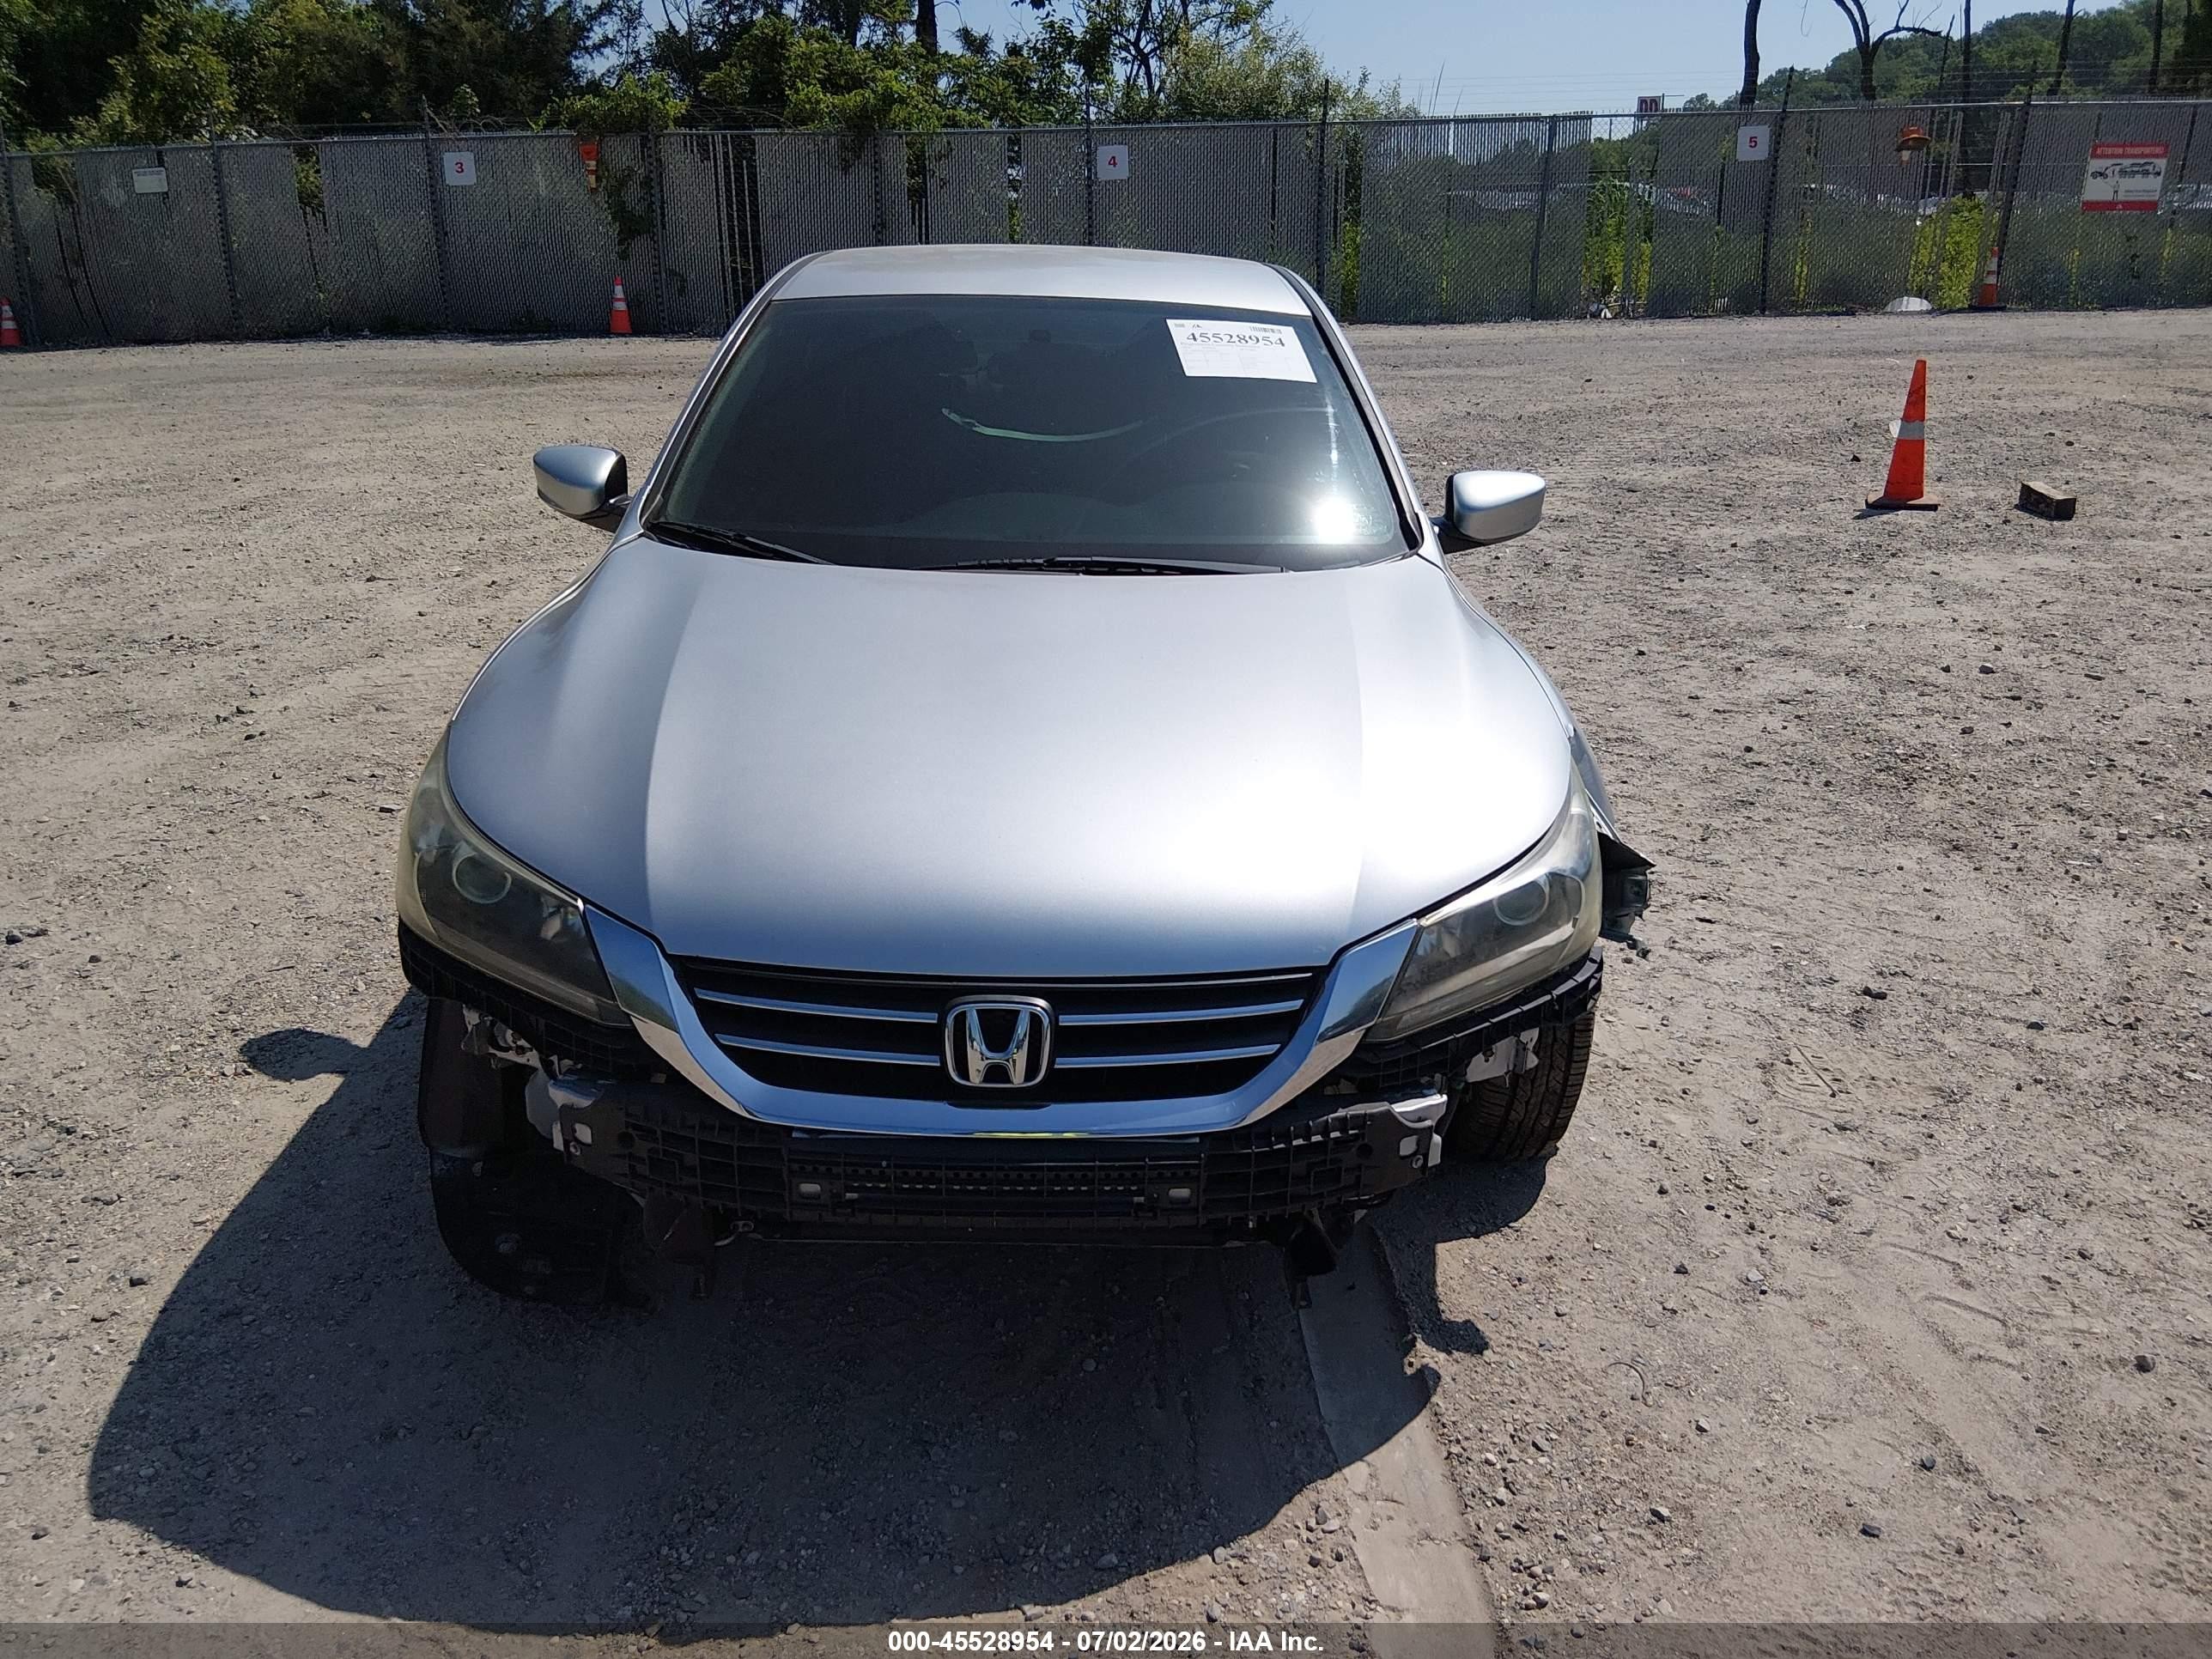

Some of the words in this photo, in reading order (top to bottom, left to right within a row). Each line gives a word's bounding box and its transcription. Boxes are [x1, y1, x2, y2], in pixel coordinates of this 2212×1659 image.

[1749, 136, 1758, 149] 5
[454, 161, 465, 173] 3
[1108, 155, 1118, 167] 4
[1187, 332, 1285, 347] 45528954
